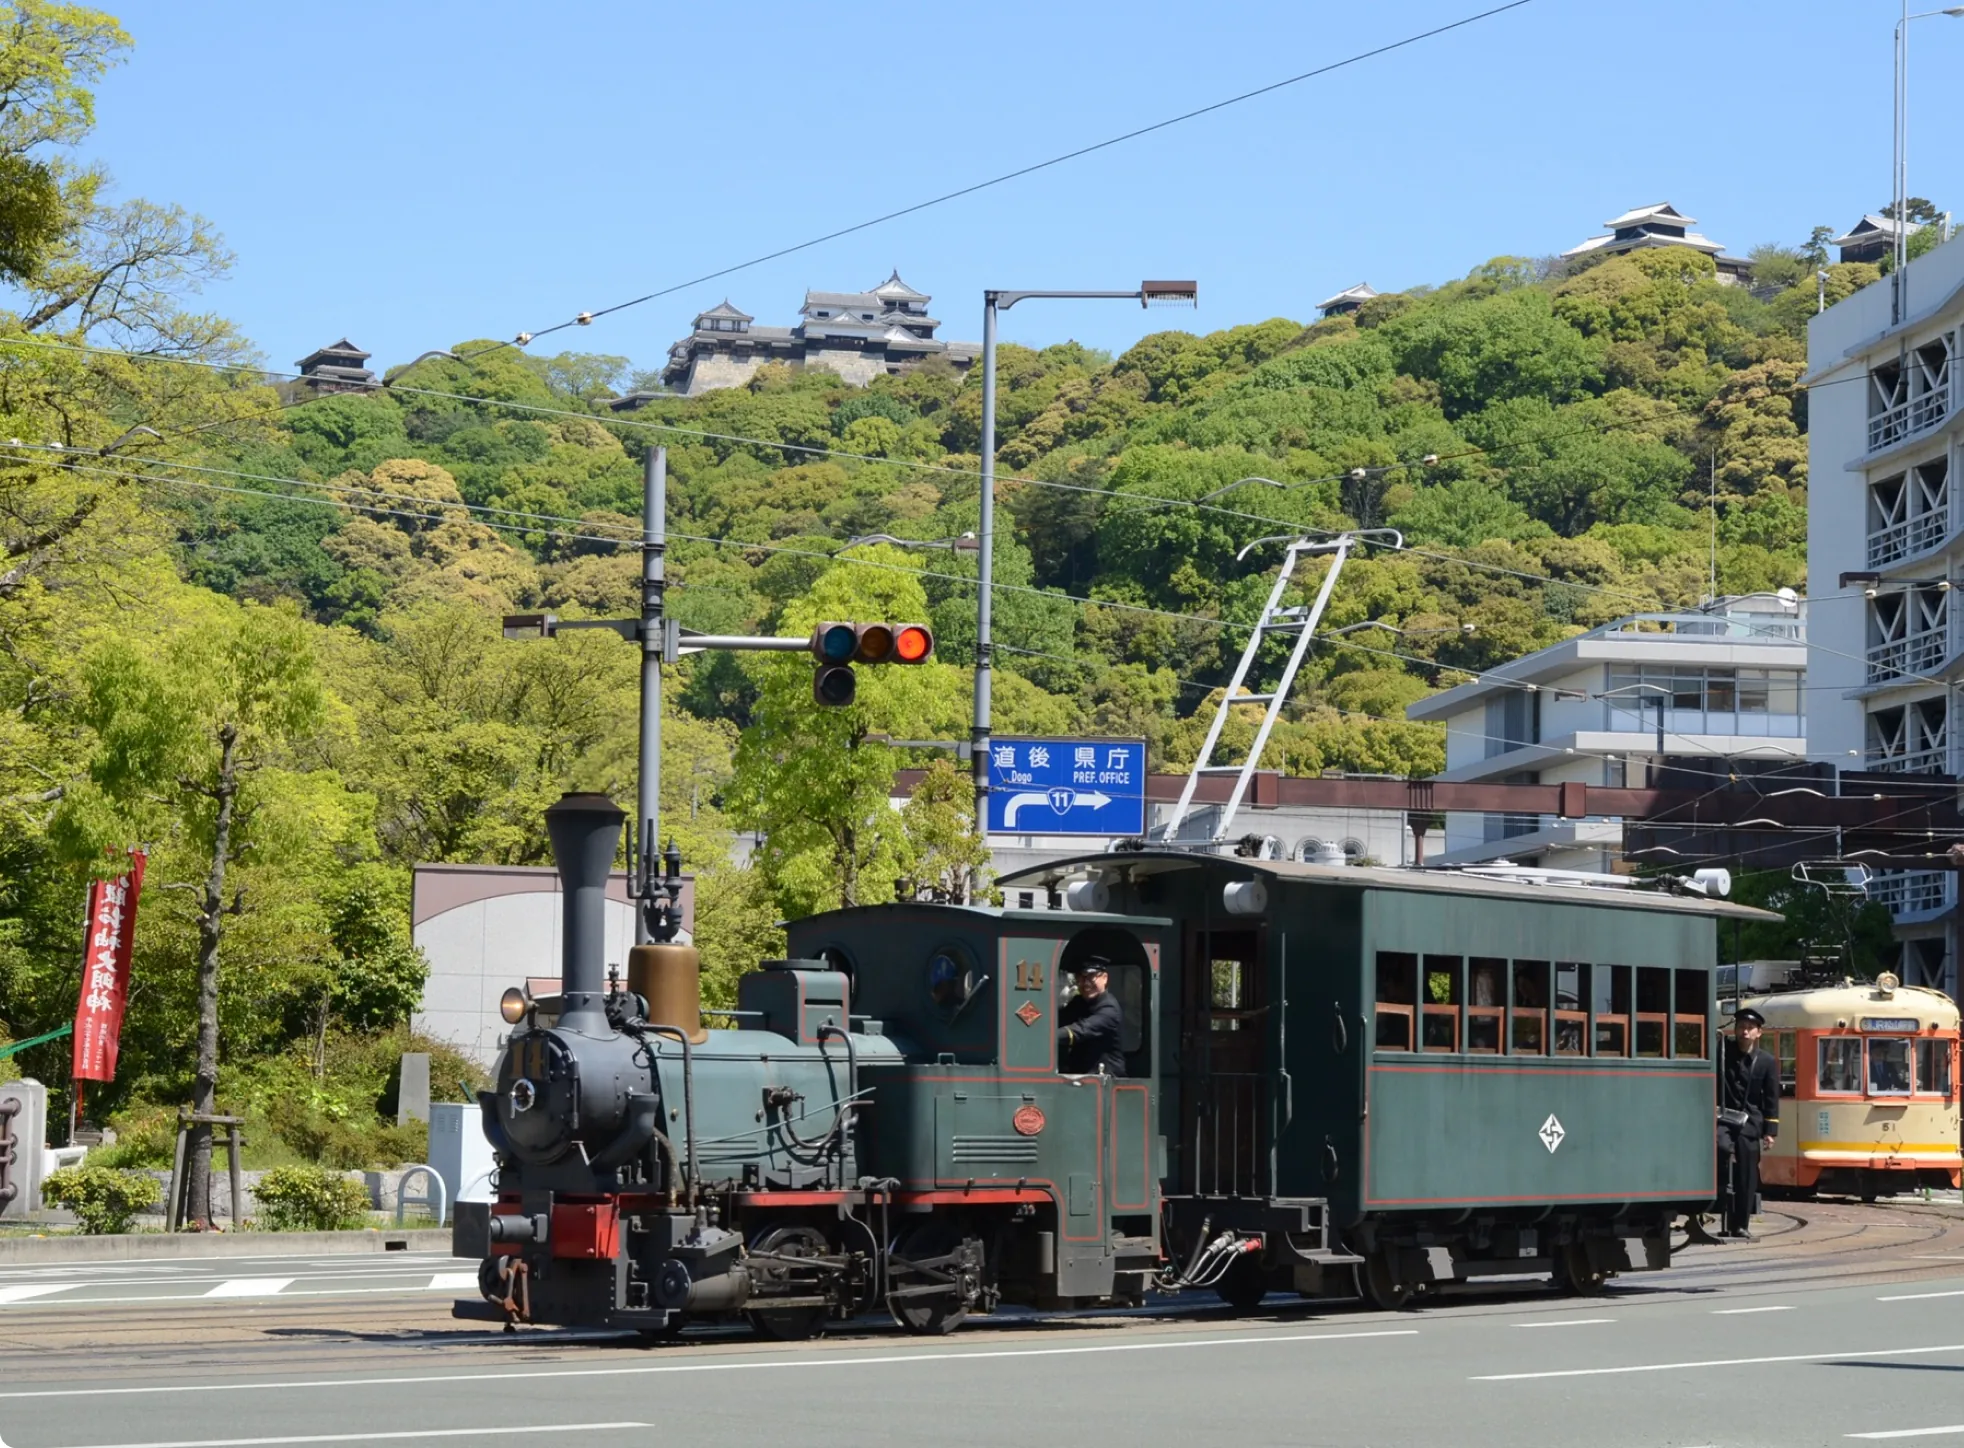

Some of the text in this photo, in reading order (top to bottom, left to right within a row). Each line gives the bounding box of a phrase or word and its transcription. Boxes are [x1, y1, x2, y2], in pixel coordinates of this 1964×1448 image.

[993, 745, 1050, 768] 道後
[1074, 747, 1129, 769] 県庁
[1011, 770, 1032, 784] Dogo
[1073, 771, 1130, 784] PREF. OFFICE
[1052, 793, 1068, 807] 11
[1014, 959, 1044, 991] 14
[509, 1041, 545, 1080] 14
